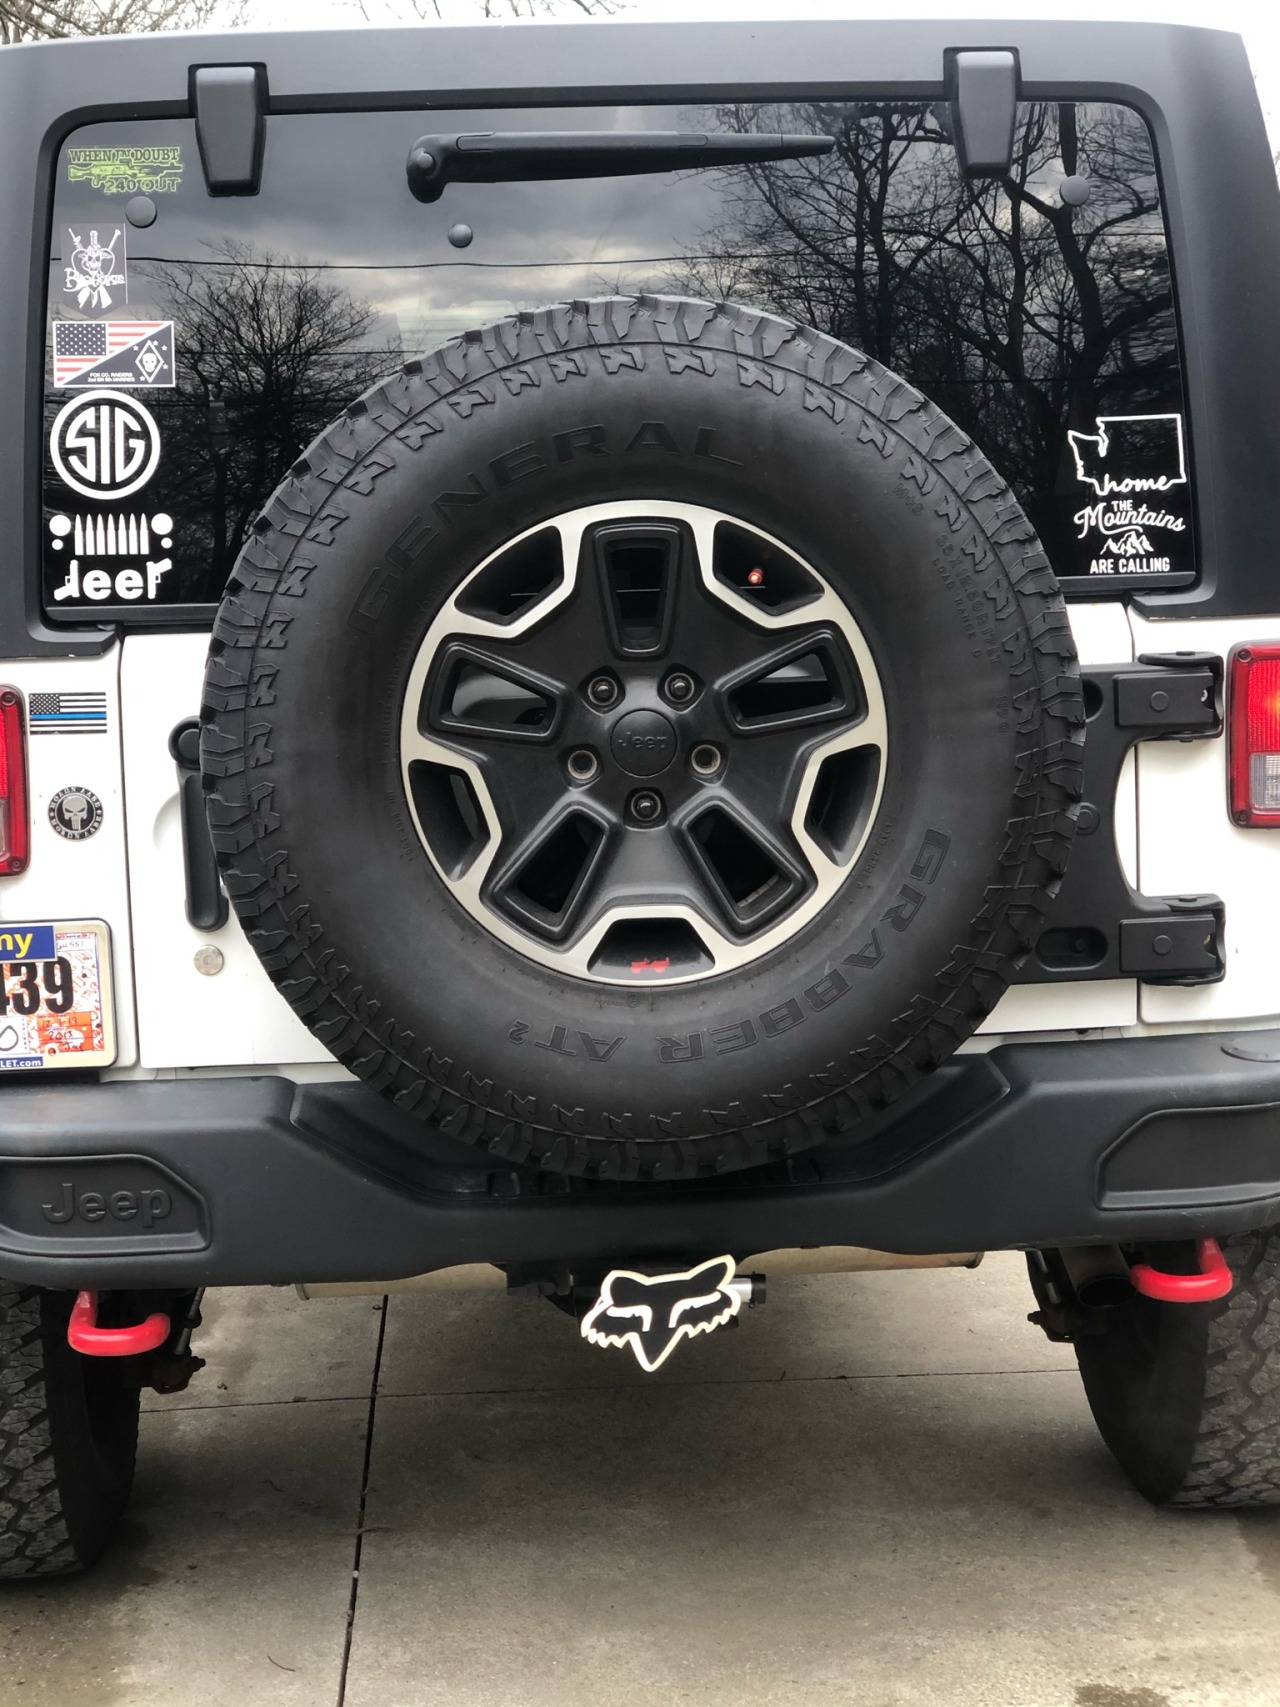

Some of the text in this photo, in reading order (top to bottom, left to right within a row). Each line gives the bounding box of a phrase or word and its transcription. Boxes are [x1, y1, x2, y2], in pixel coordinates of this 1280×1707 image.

[69, 147, 180, 162] WHEN IN DOUBT
[104, 178, 180, 192] 240 OUT
[65, 405, 146, 484] SIG
[1103, 473, 1172, 492] home
[1111, 500, 1133, 511] THE
[347, 421, 744, 629] GENERAL
[1074, 502, 1186, 539] Mountains
[1090, 557, 1170, 574] ARE CALLING
[617, 730, 669, 752] Jeep
[656, 828, 951, 1063] GRABBER
[40, 1182, 172, 1229] Jeep
